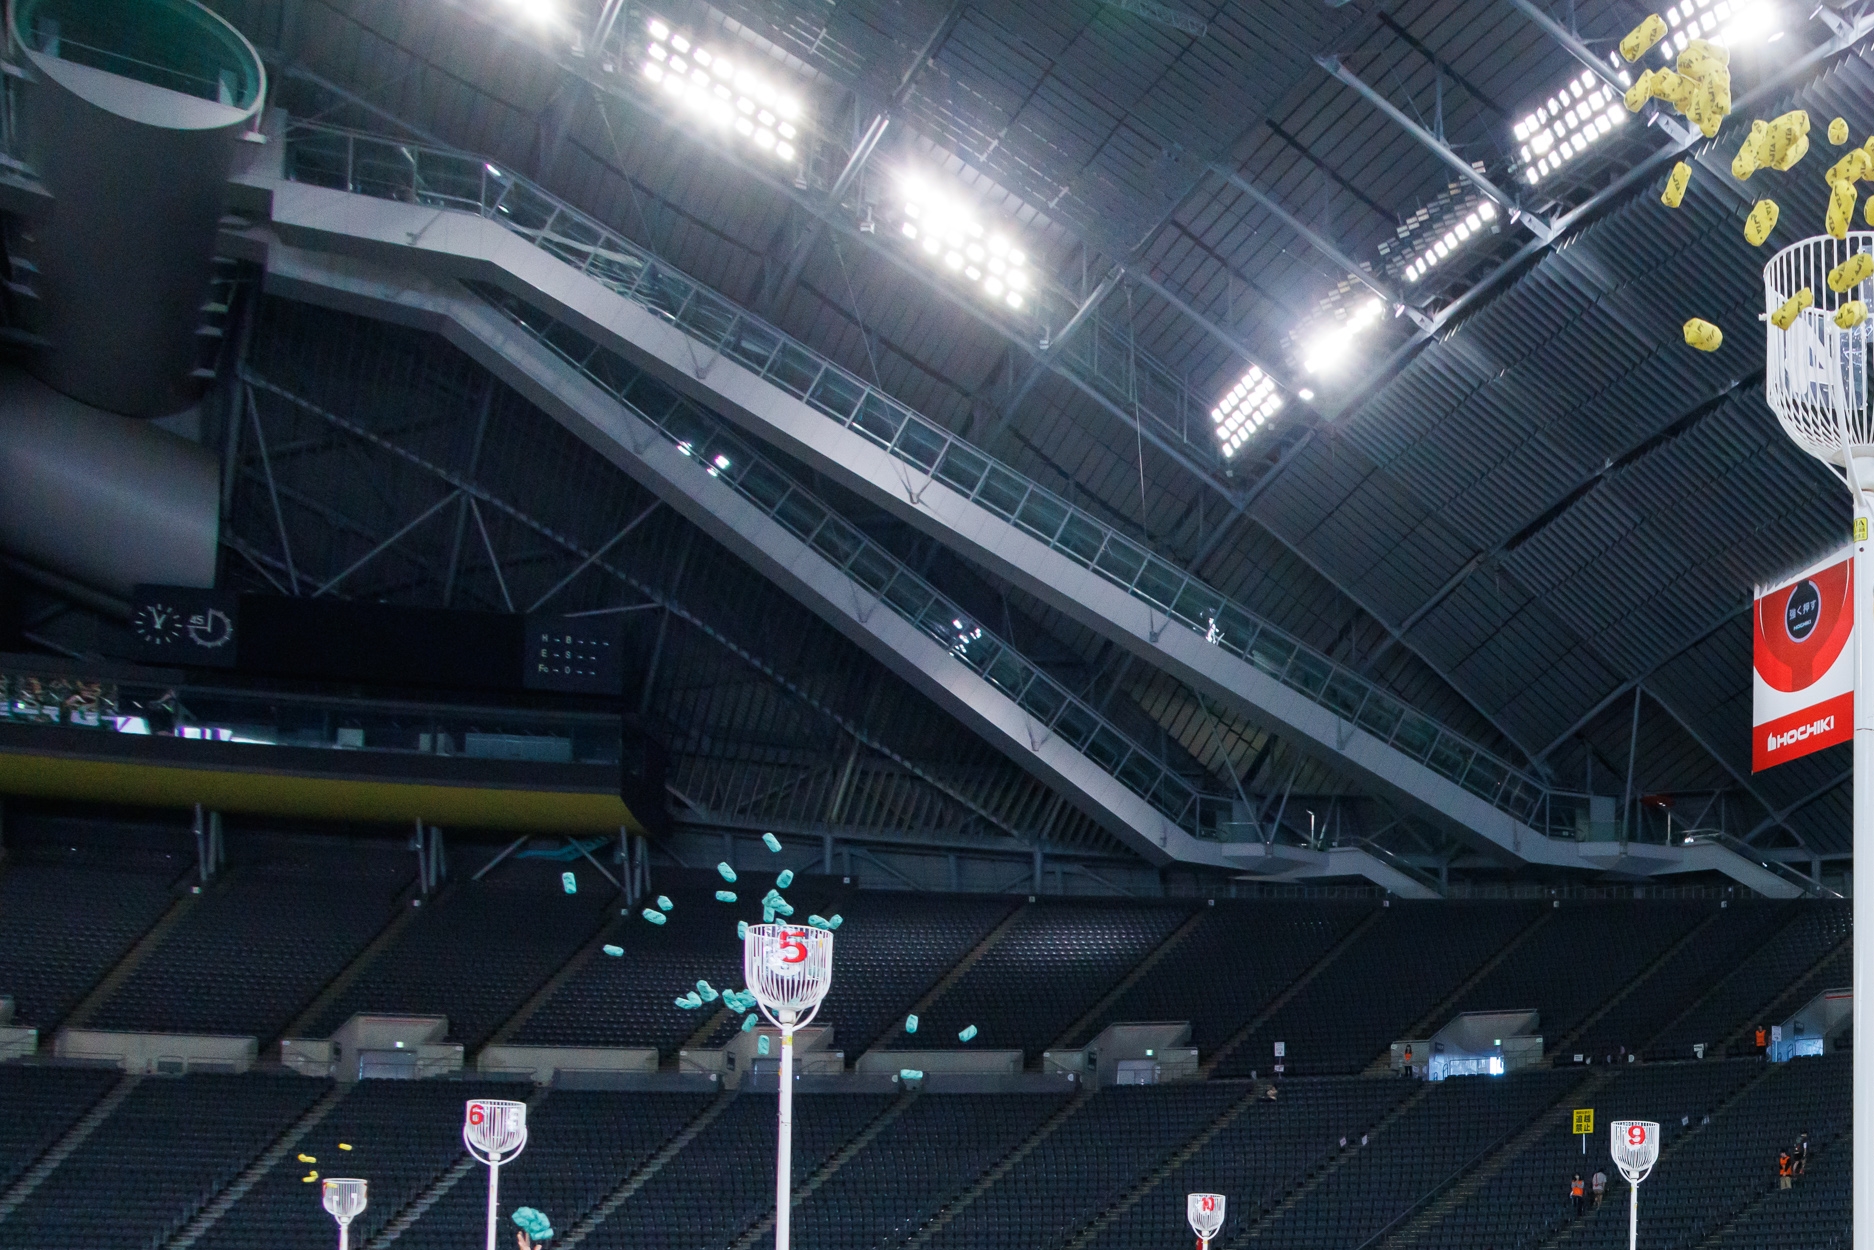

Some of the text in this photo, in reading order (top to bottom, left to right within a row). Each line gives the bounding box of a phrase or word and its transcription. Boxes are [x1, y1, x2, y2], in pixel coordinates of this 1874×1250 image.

[1789, 599, 1817, 621] 強く押す
[1776, 715, 1835, 749] HOCHIKI
[779, 930, 808, 964] 5
[469, 1104, 484, 1126] 6
[1575, 1123, 1591, 1132] 禁止
[1628, 1125, 1646, 1145] 9
[1201, 1196, 1215, 1212] 10
